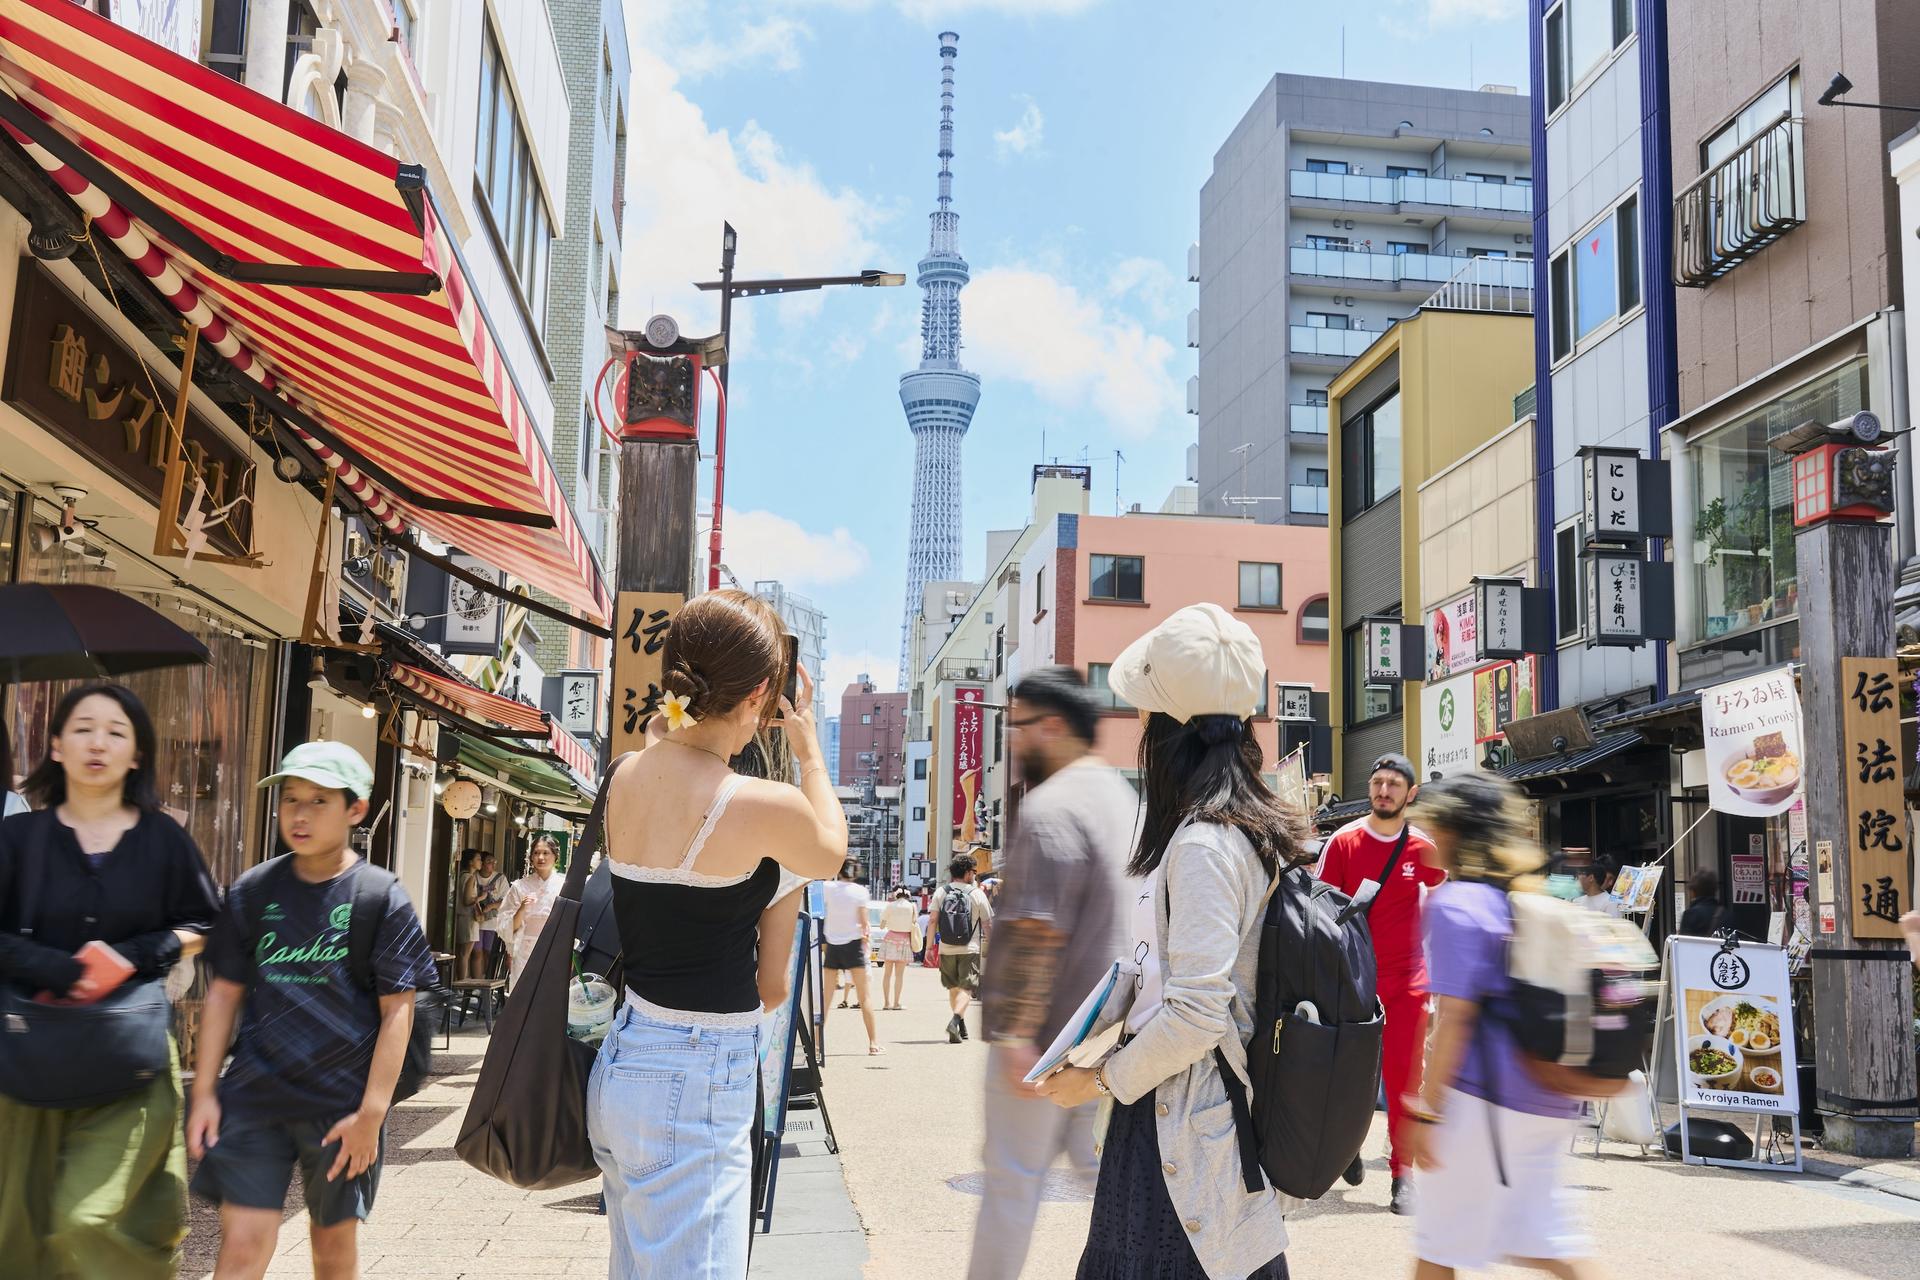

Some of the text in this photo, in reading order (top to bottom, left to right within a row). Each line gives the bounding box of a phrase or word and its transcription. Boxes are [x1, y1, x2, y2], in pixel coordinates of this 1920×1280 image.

[1610, 463, 1626, 526] にしだ
[1710, 722, 1755, 737] Ramen
[1851, 671, 1904, 924] 伝法院通
[1697, 1091, 1779, 1108] Yoroiya Ramen
